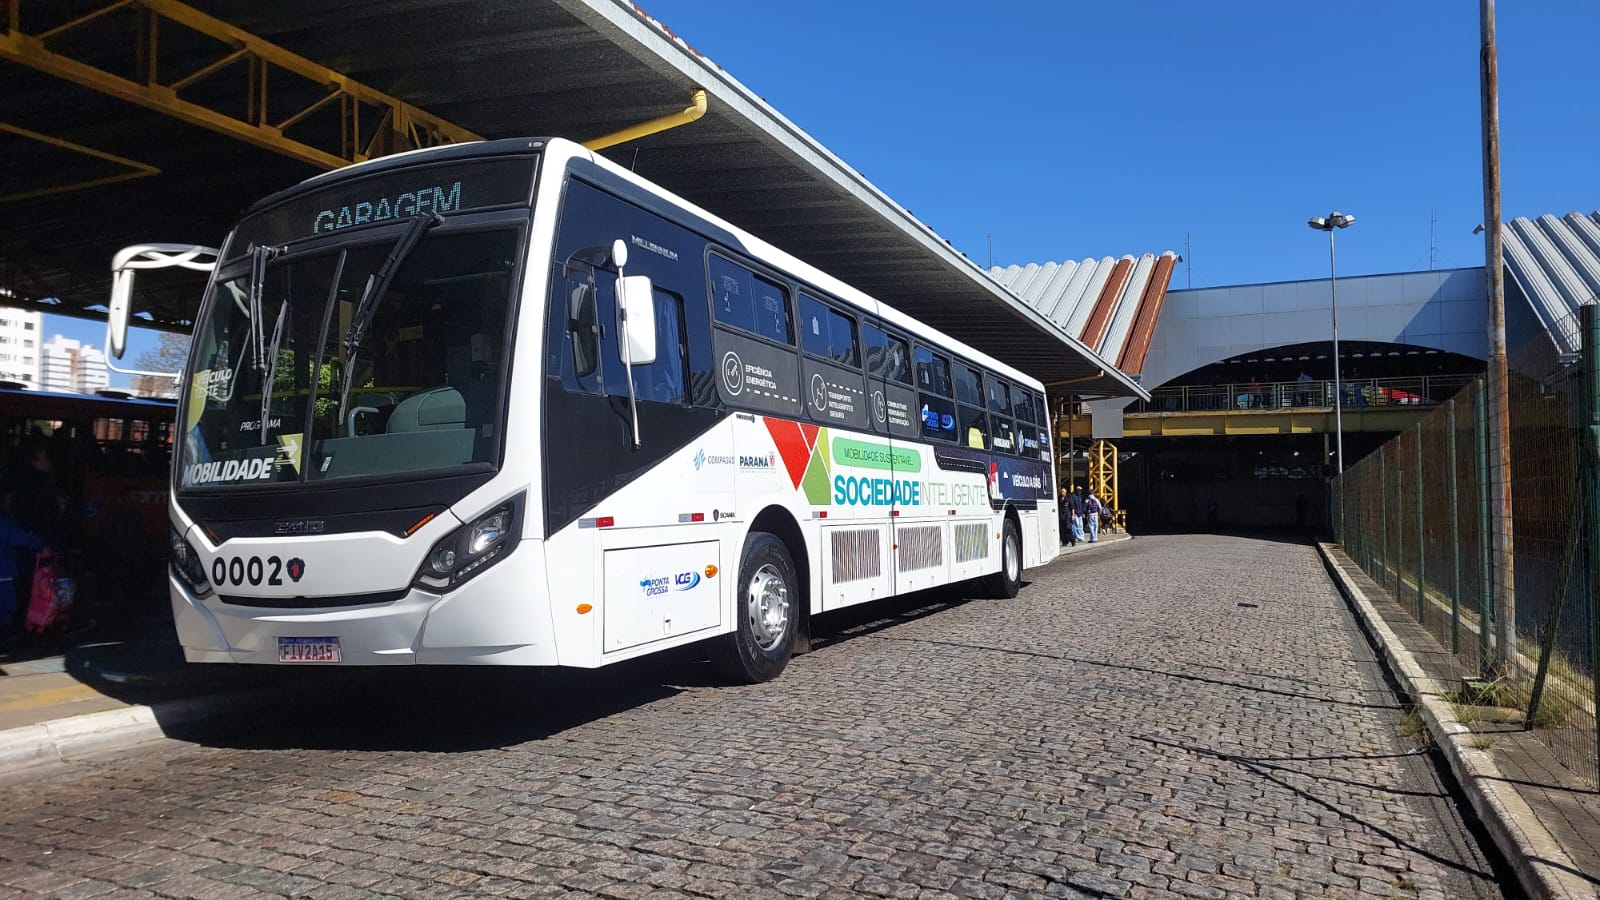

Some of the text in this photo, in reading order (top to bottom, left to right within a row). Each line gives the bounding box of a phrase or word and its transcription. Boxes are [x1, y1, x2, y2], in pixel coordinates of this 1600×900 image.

[313, 181, 462, 234] GARAGEM
[745, 364, 772, 378] EFICIÊNCIA
[745, 375, 776, 390] ENERGÉTICA
[240, 418, 281, 431] PROGAMA
[739, 454, 769, 468] PARANÁ
[844, 447, 878, 462] MOBILIDADE
[183, 458, 275, 484] MOBILIDADE
[212, 556, 283, 586] 0002
[651, 577, 669, 587] PONTA
[675, 572, 691, 585] VCG
[646, 585, 668, 597] GROSSA
